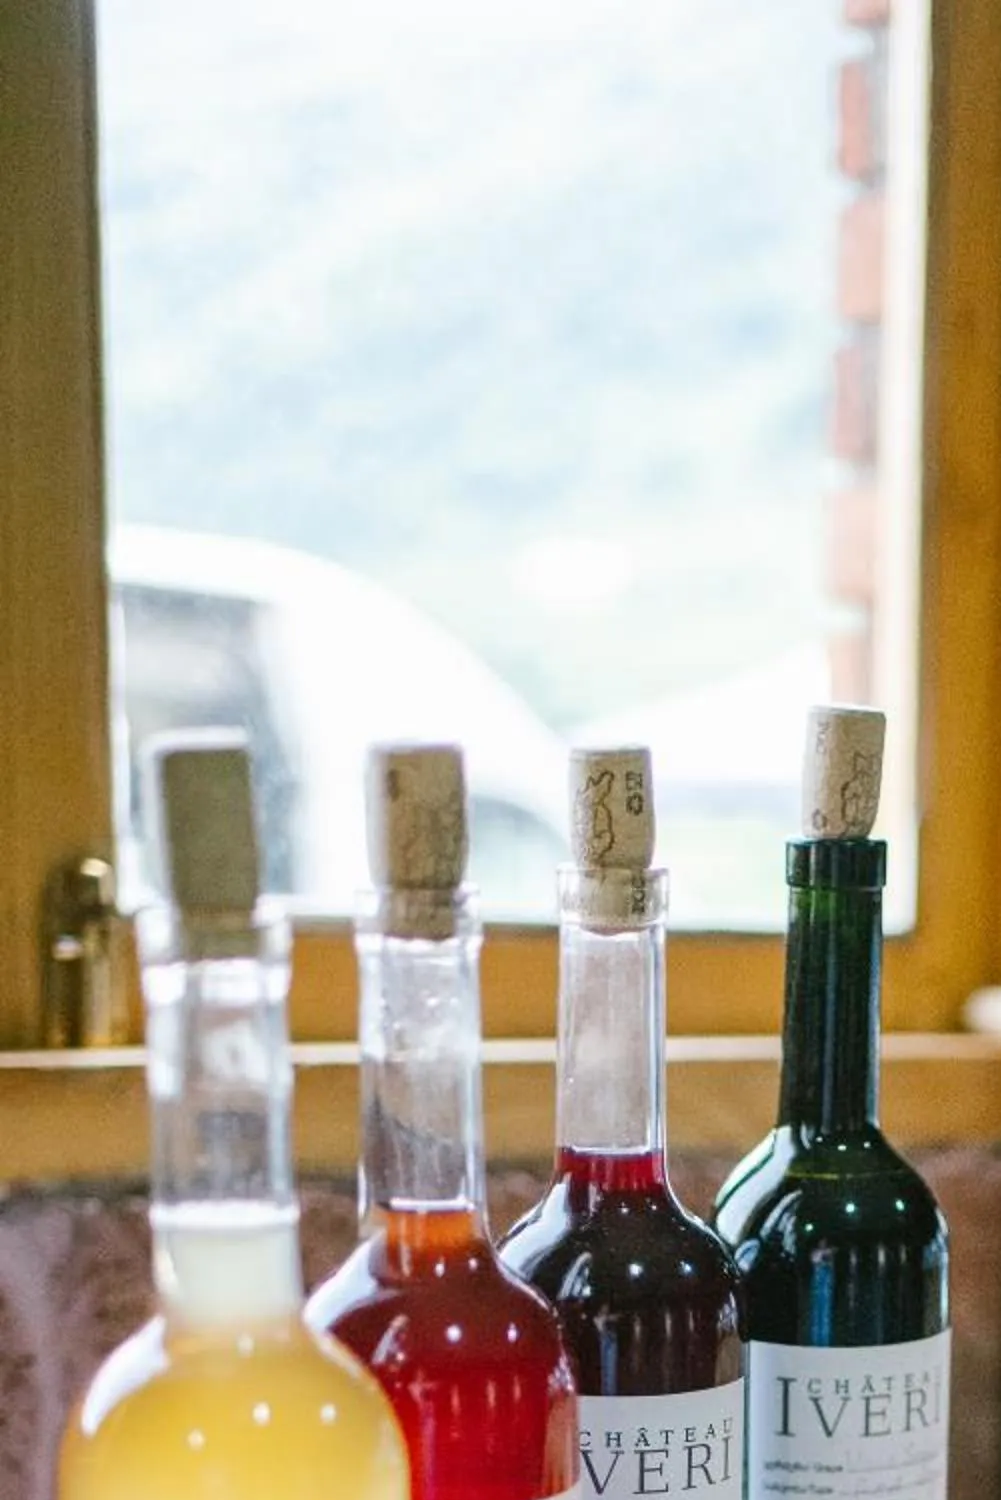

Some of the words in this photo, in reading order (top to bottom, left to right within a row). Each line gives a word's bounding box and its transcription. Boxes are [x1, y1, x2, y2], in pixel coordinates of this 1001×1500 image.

[775, 1376, 941, 1438] IVERI
[807, 1366, 940, 1395] CHÂTEA
[579, 1435, 732, 1496] VERI
